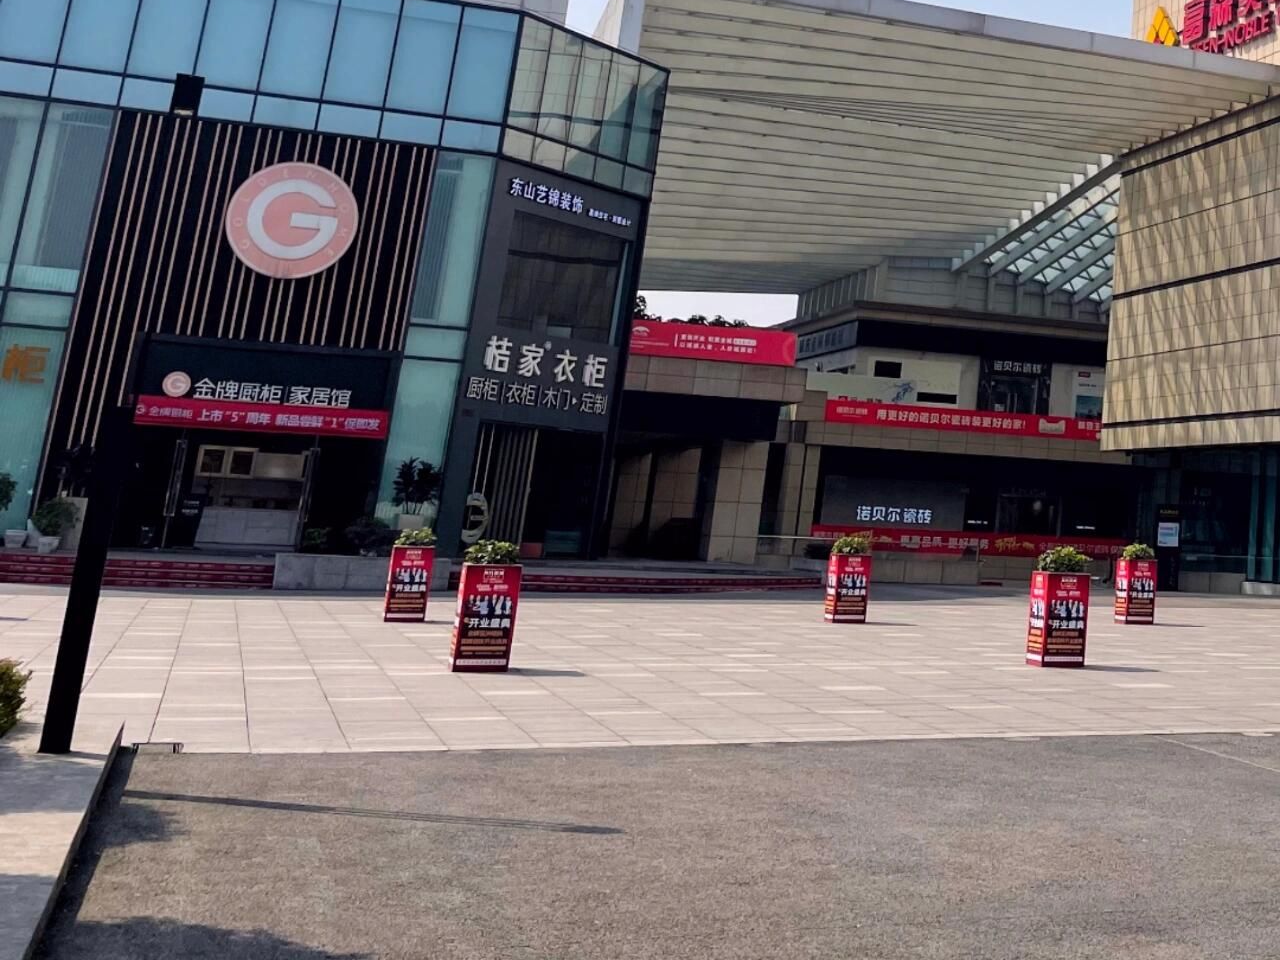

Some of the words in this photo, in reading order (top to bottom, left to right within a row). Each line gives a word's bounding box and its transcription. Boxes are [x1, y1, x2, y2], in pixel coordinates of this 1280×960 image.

[510, 177, 584, 214] 东山艺锦装饰
[2, 344, 51, 384] 柜
[283, 386, 352, 409] 家居馆
[856, 505, 933, 525] 诺贝尔瓷砖
